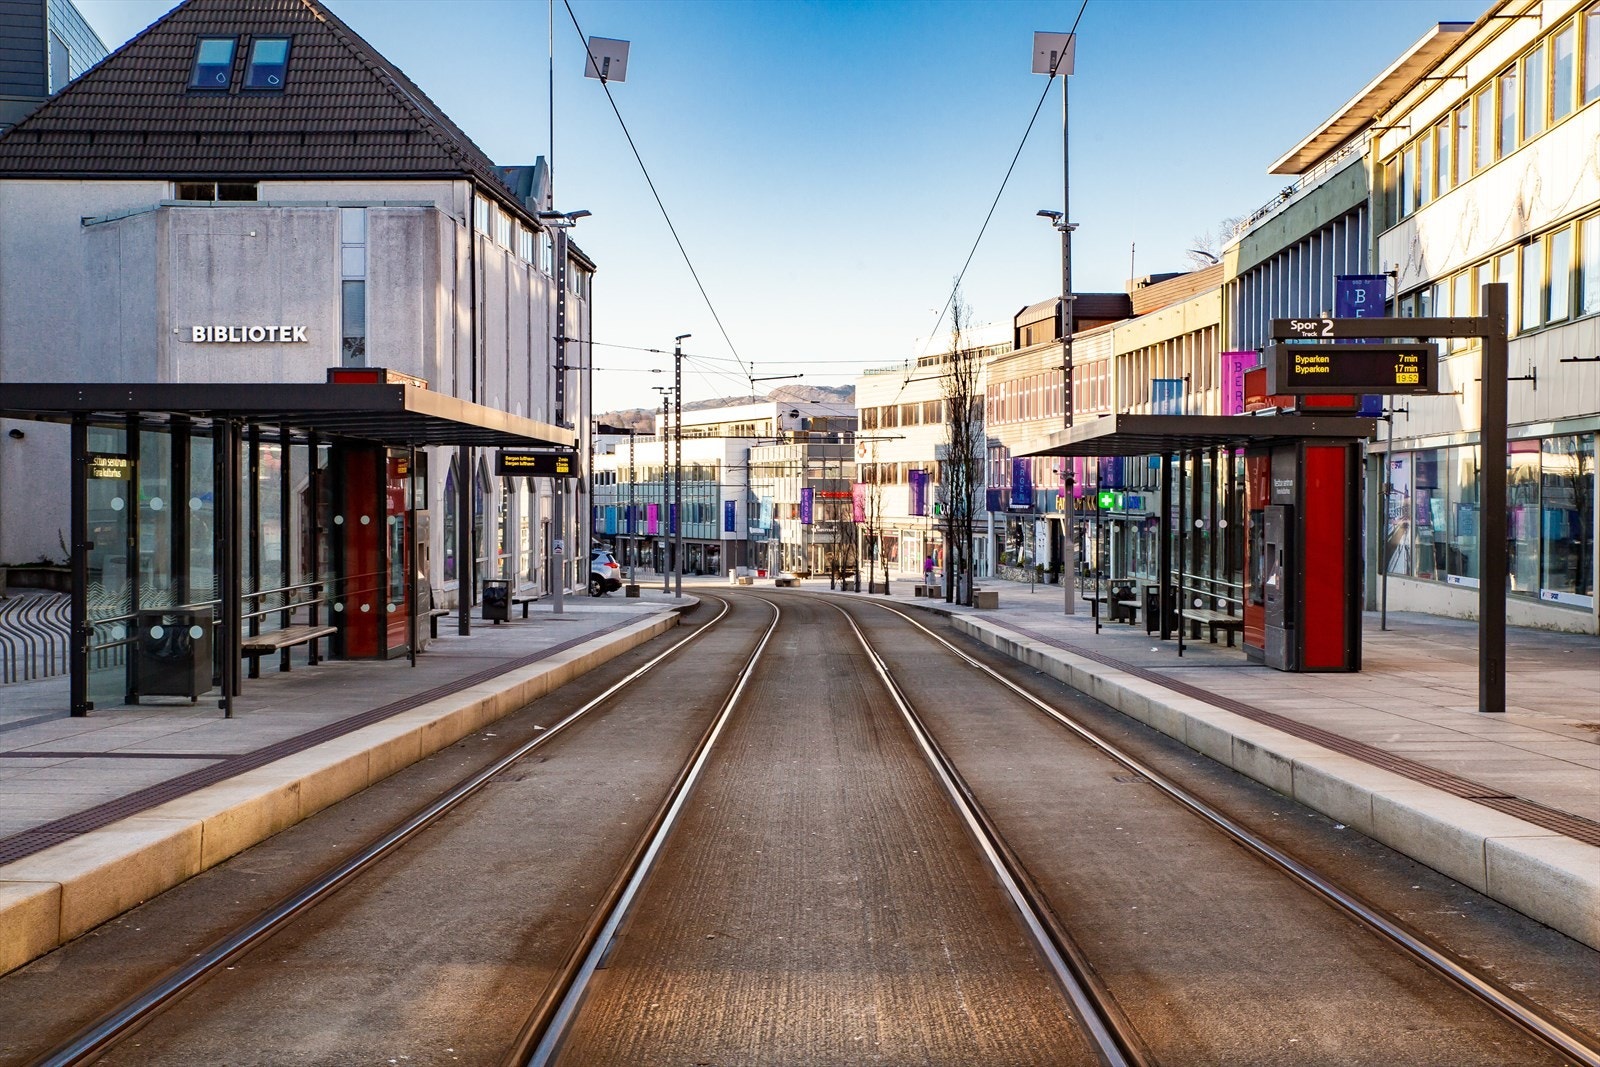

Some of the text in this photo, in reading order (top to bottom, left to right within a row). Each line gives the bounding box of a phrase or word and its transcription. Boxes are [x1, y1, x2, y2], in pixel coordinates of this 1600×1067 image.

[192, 325, 308, 342] BIBLIOTEK
[1290, 320, 1334, 337] Spor 2
[1295, 355, 1330, 364] Byparken
[1295, 364, 1330, 374] Byparken
